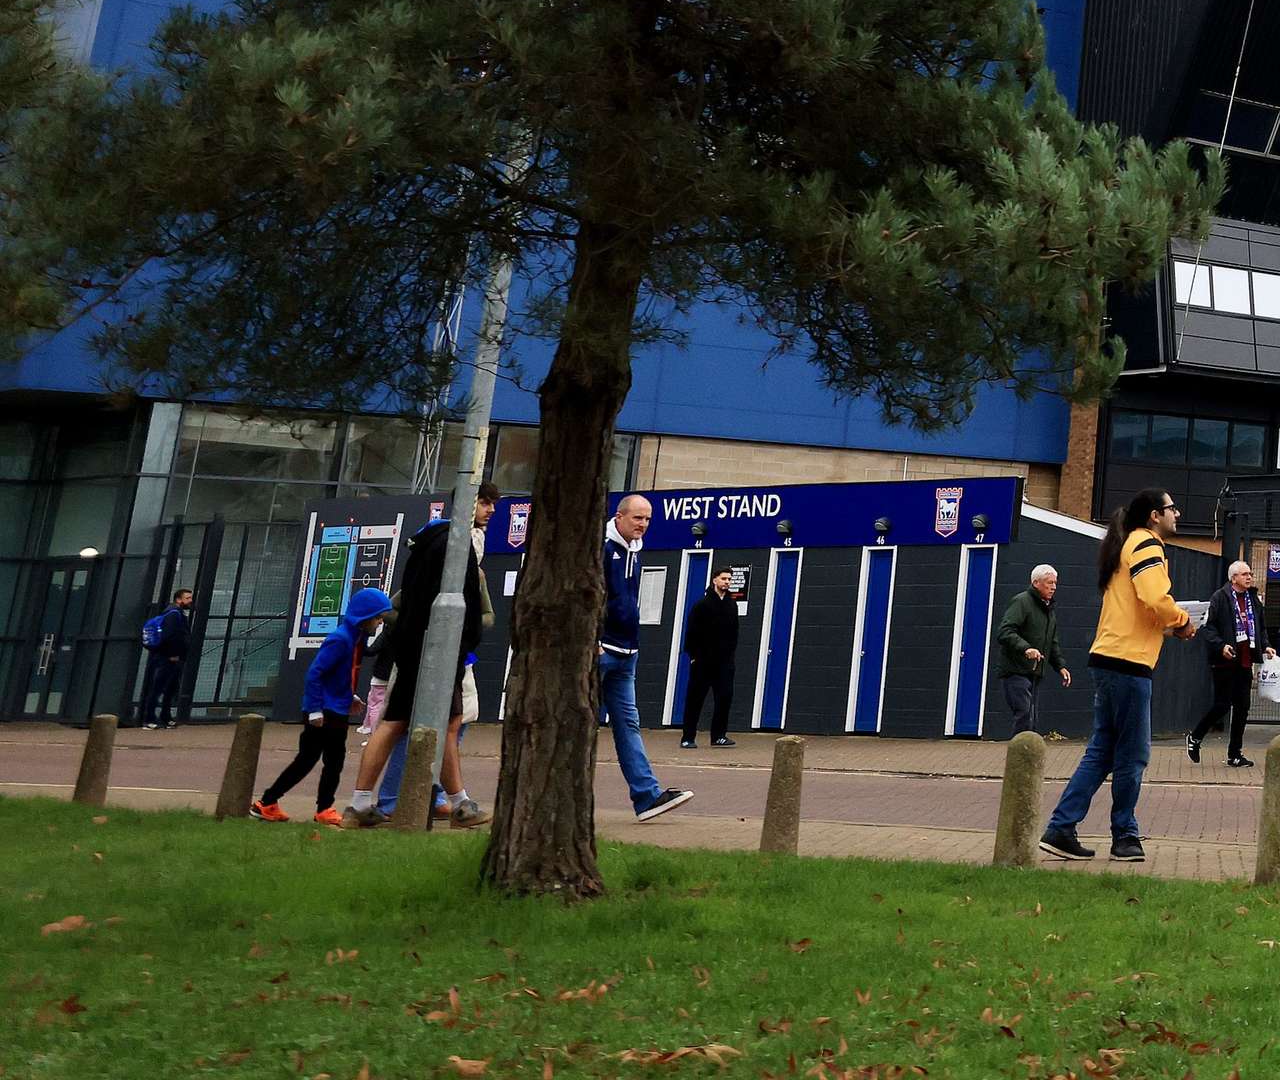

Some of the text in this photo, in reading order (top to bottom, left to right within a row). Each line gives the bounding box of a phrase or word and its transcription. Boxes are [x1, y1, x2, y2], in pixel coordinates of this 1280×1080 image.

[663, 494, 781, 520] WEST STAND
[784, 538, 792, 546] 45
[876, 535, 885, 545] 46
[975, 533, 984, 543] 47
[694, 540, 702, 548] 44
